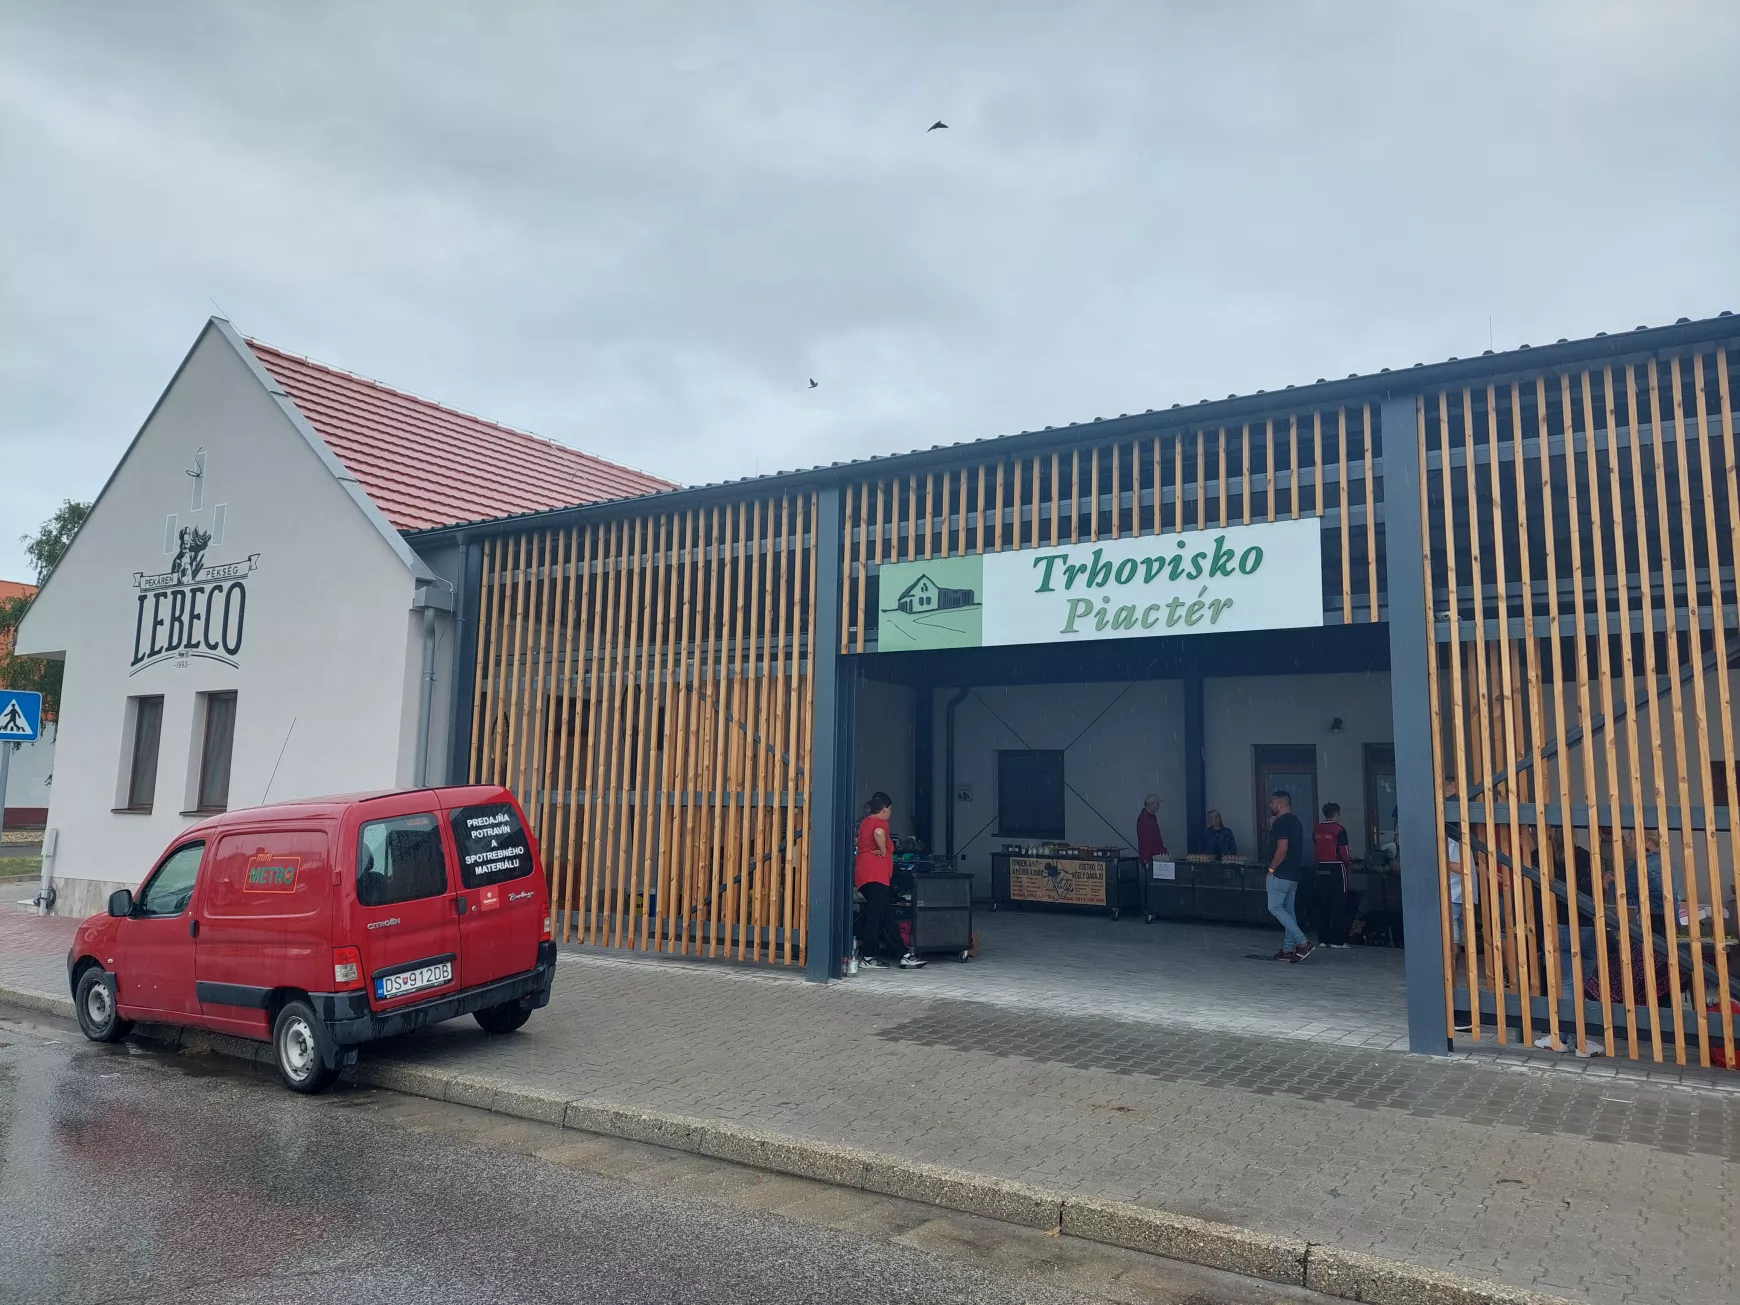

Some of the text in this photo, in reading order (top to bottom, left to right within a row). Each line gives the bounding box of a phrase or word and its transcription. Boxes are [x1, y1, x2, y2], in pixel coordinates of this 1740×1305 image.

[206, 565, 238, 579] PÉKSÉG
[1033, 535, 1264, 593] Trhovisko
[1059, 585, 1234, 633] Piactér
[131, 581, 246, 667] LEBECO
[466, 813, 510, 828] PREDAJŇA
[471, 825, 511, 839] POTRAVÍN
[491, 839, 497, 847] A
[465, 846, 524, 864] SPOTREBNÉHO
[475, 858, 519, 875] MATERIÁLU
[249, 866, 295, 885] METRO
[367, 917, 401, 930] CITROËN
